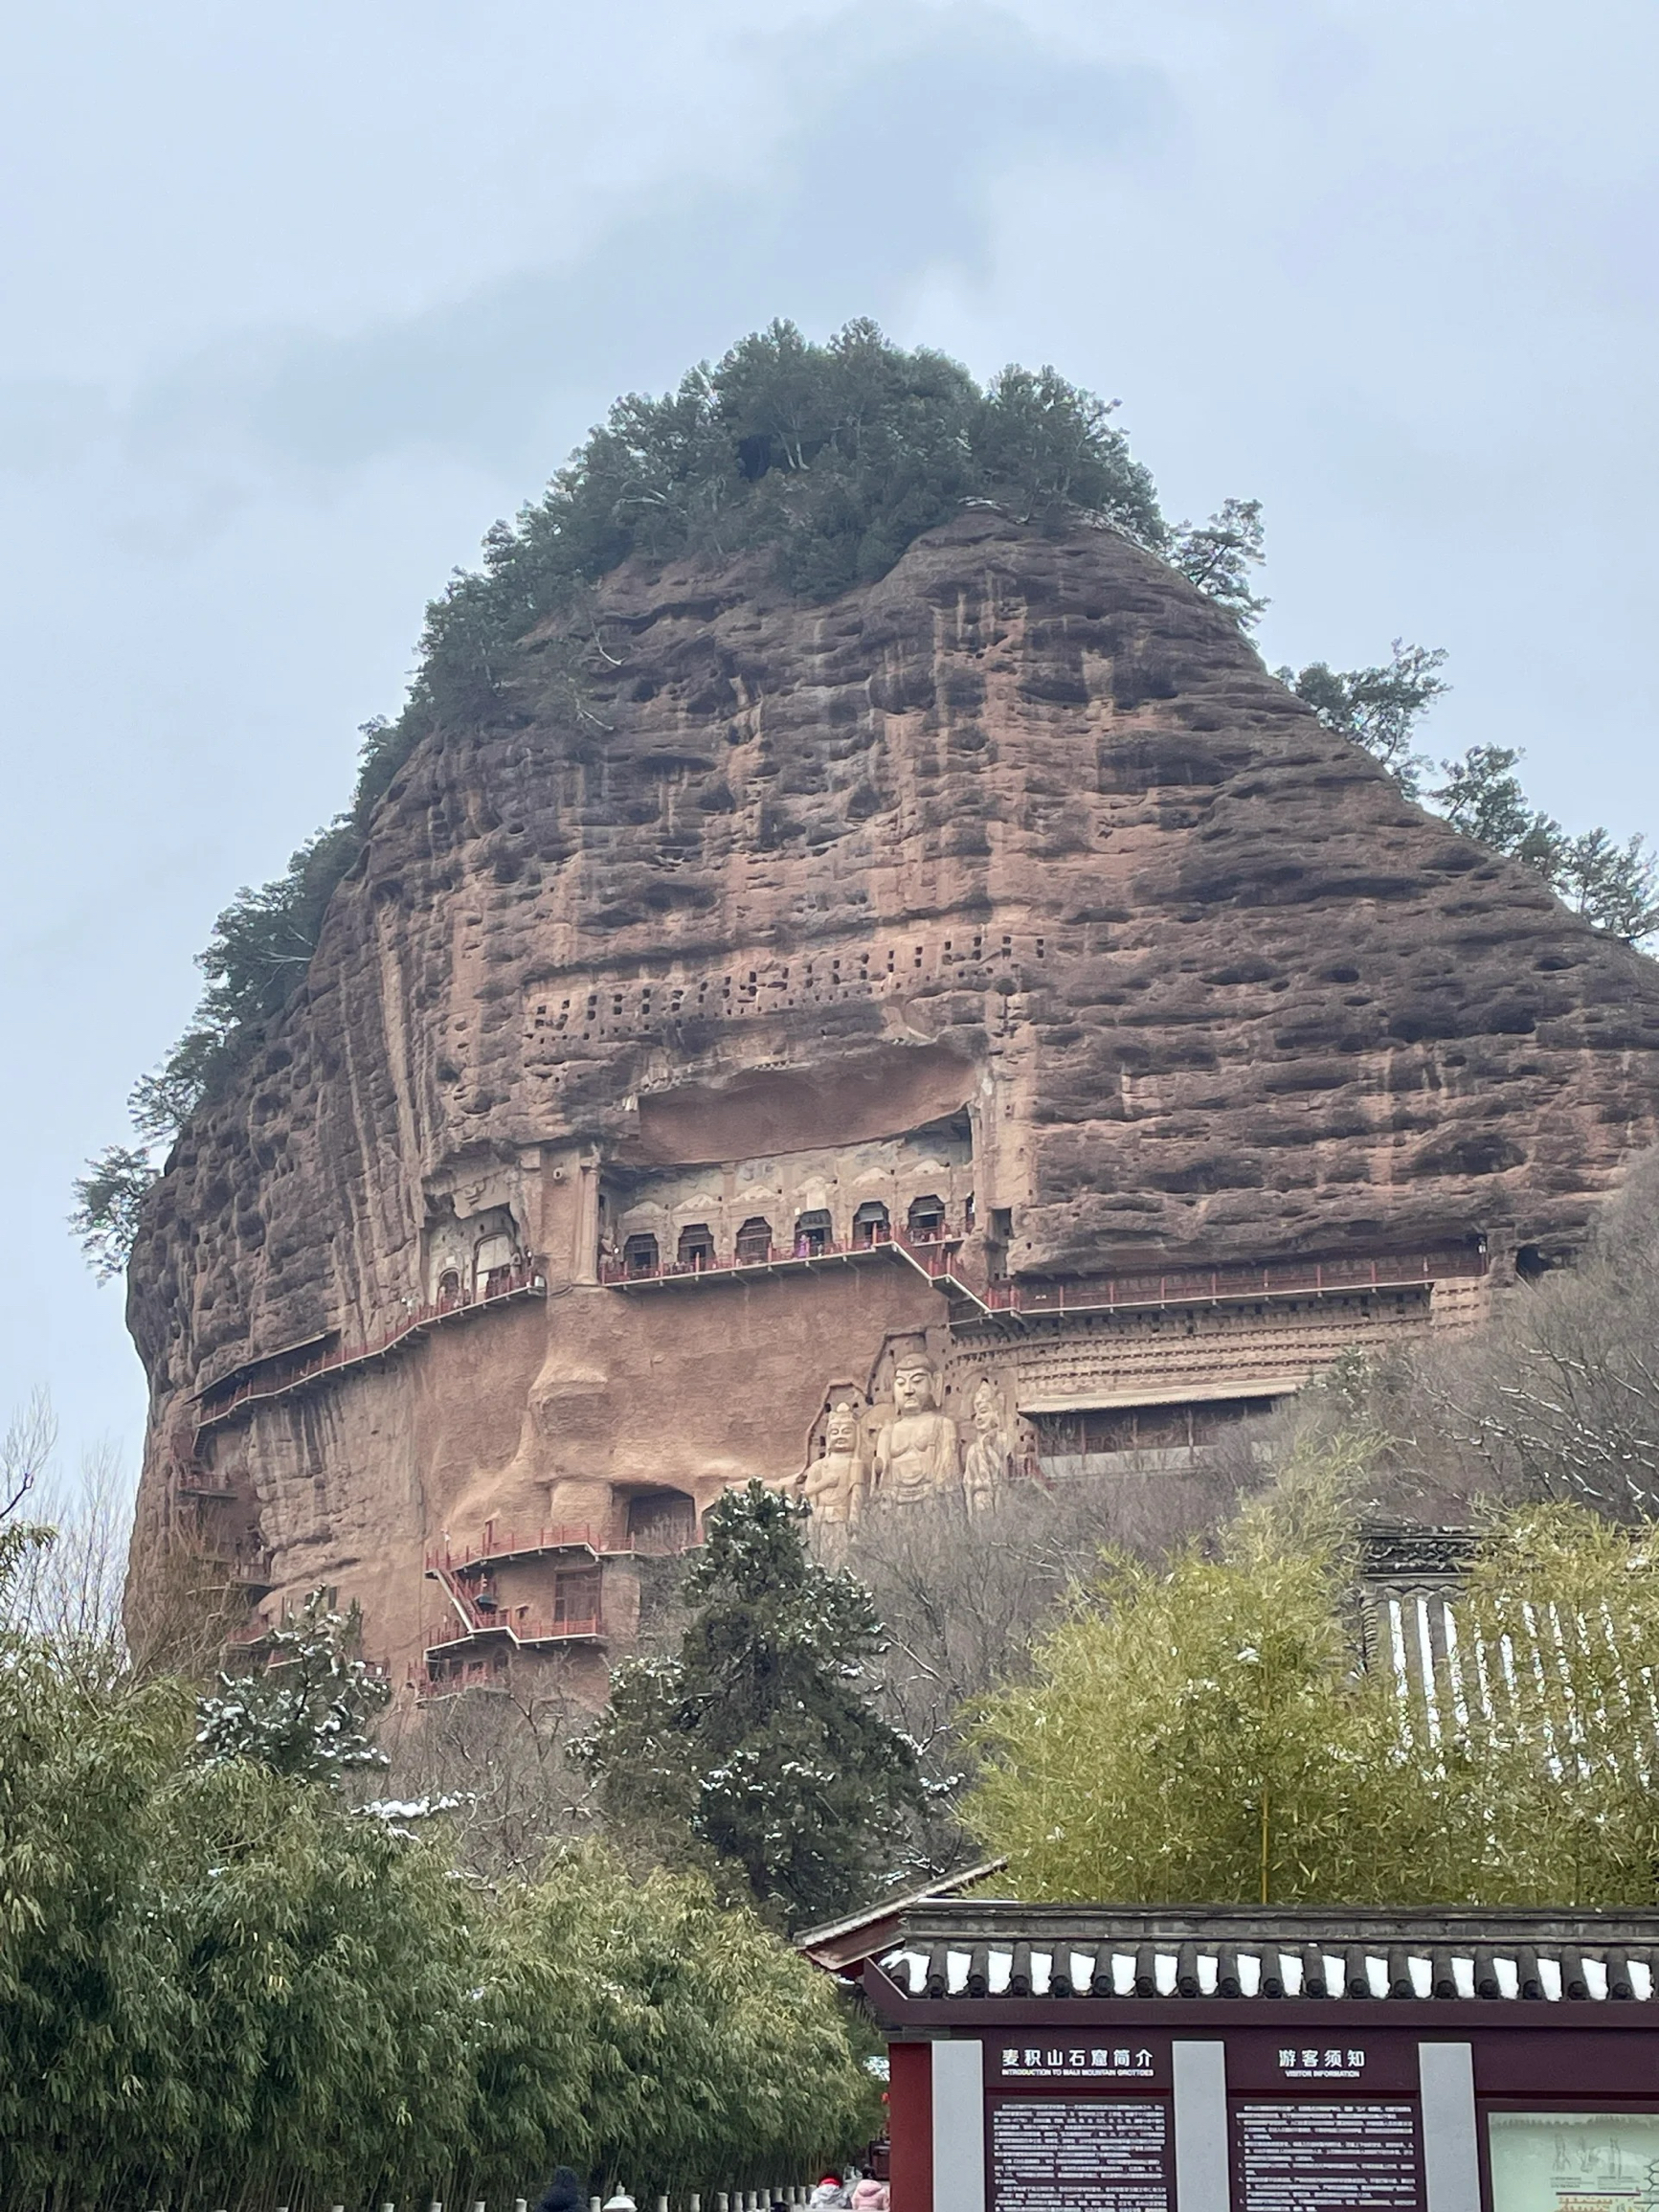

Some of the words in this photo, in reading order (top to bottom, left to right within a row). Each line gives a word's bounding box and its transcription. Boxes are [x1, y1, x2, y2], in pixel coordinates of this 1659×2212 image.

[1001, 2048, 1154, 2067] 麦积山石窟简介
[1278, 2048, 1365, 2067] 游客须知
